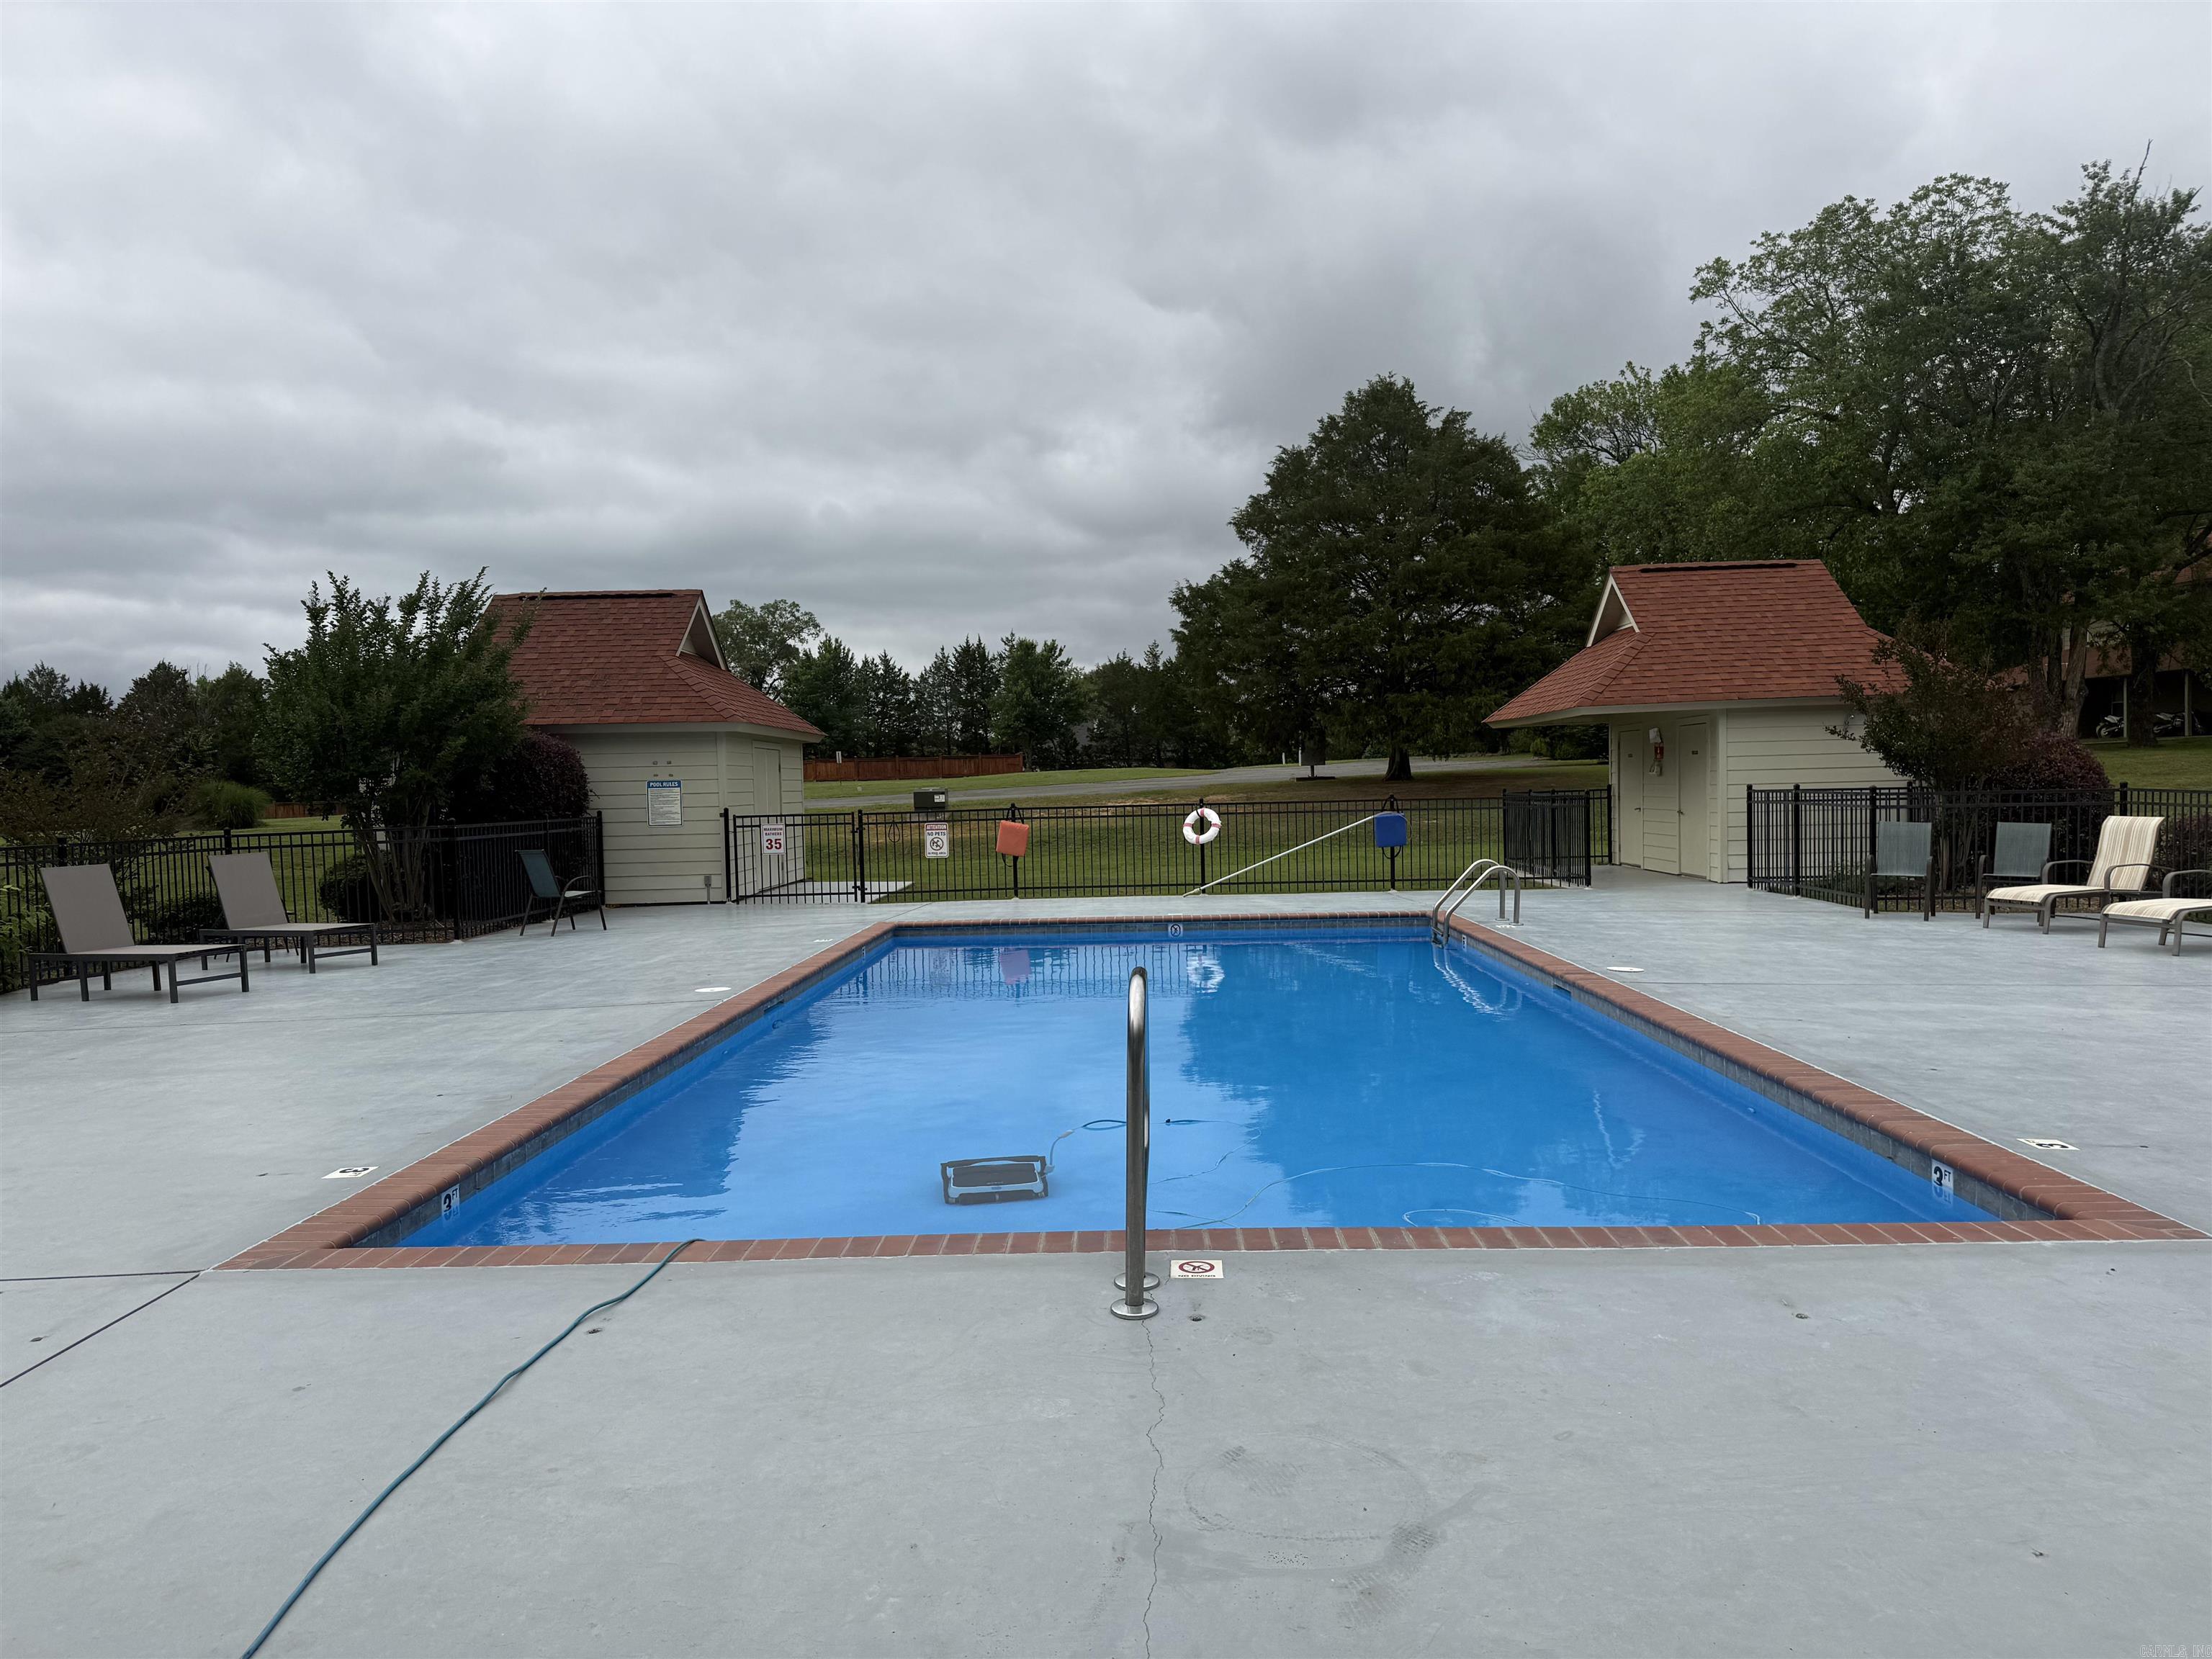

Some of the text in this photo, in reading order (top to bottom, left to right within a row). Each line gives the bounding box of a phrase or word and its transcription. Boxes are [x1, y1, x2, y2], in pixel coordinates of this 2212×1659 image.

[765, 838, 782, 850] 35
[1933, 1166, 1951, 1187] 3 FT
[444, 1188, 458, 1213] 3 FT
